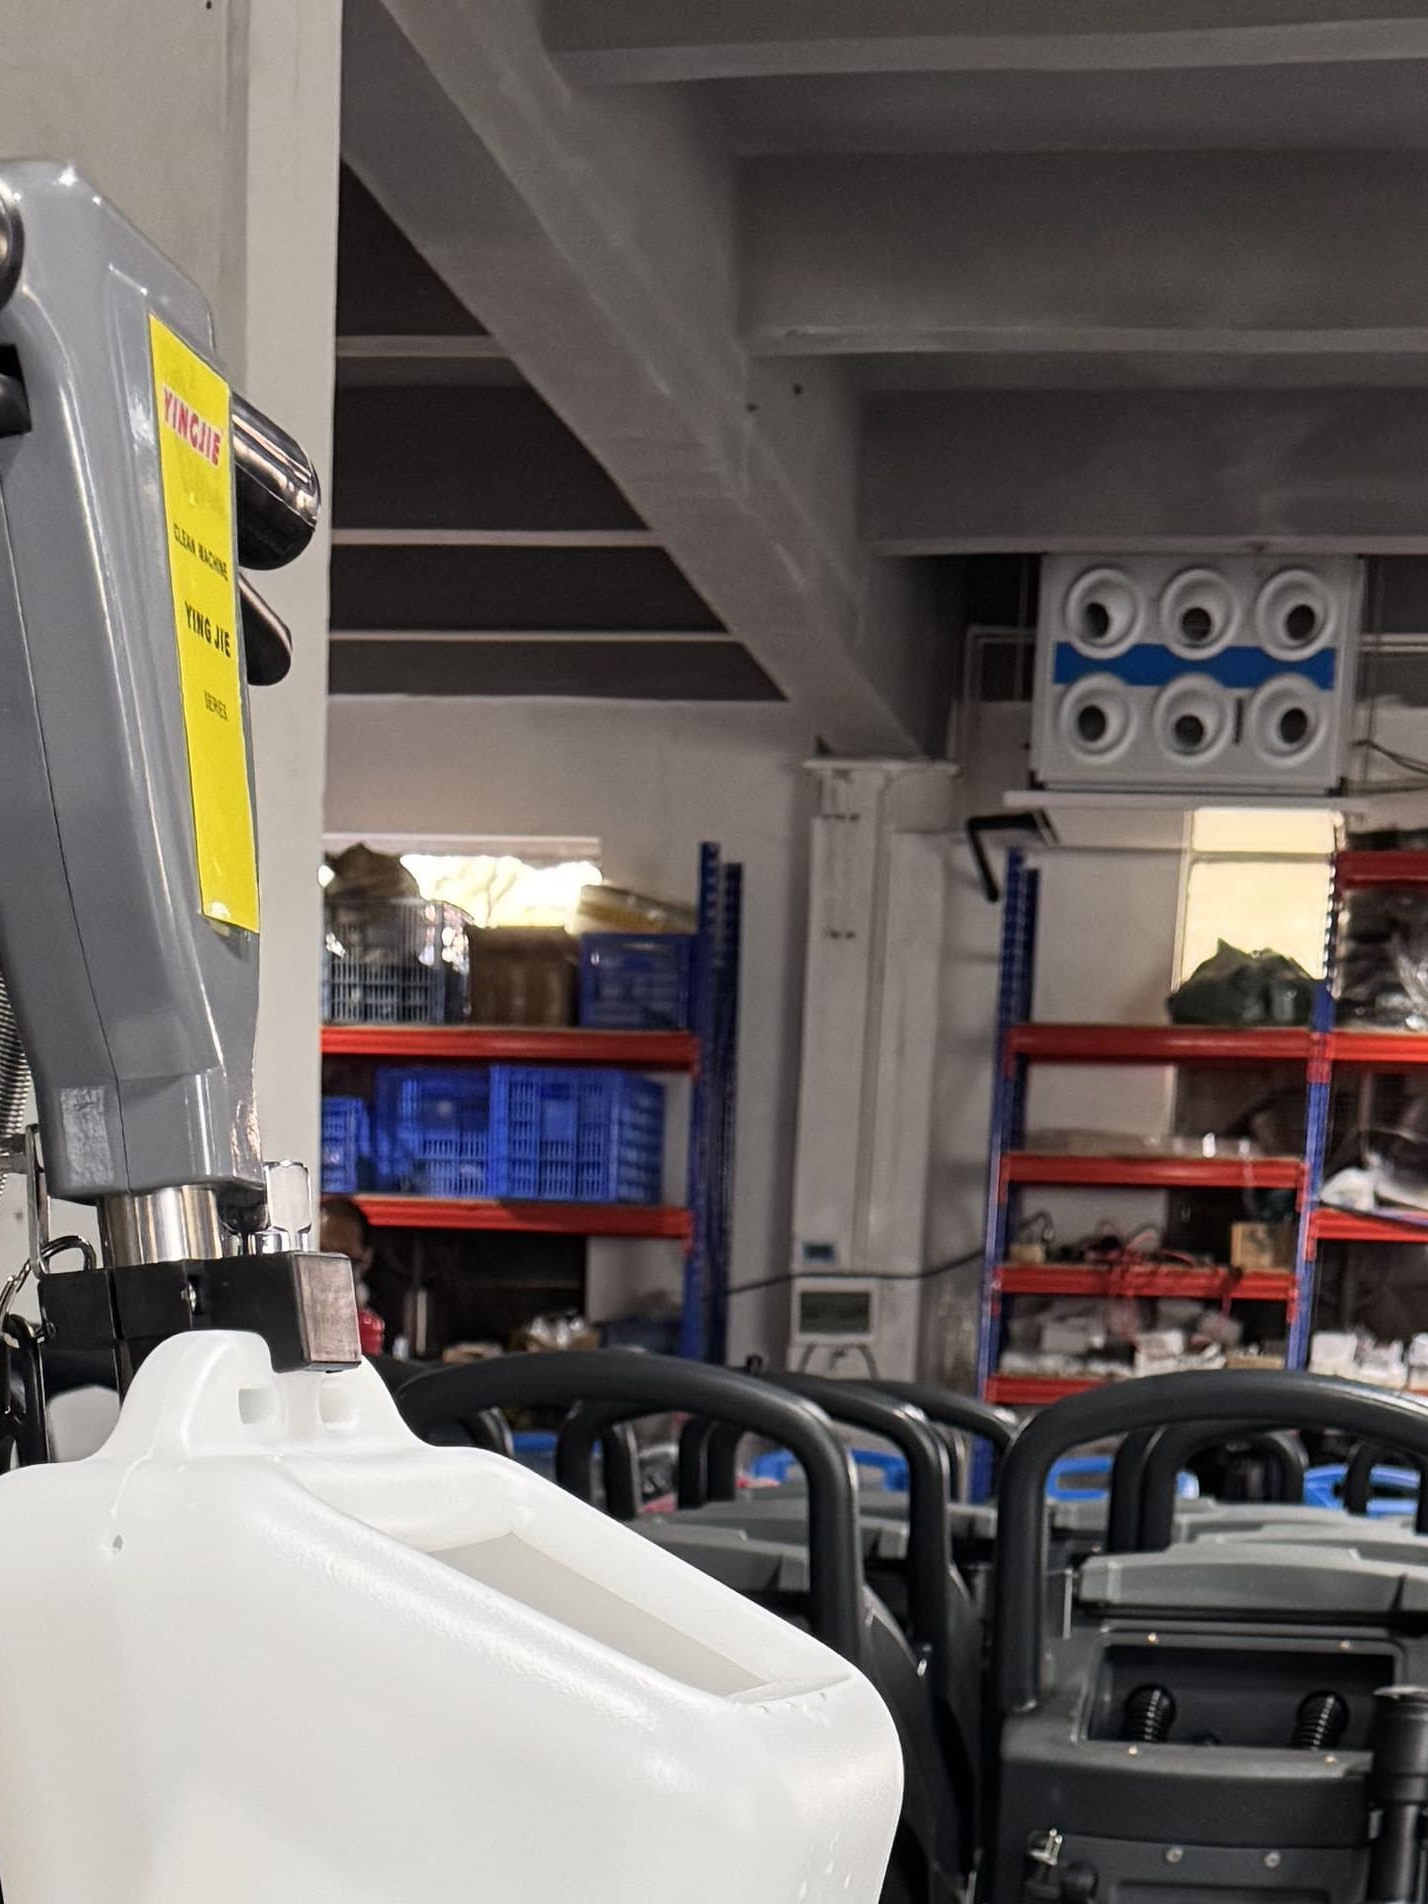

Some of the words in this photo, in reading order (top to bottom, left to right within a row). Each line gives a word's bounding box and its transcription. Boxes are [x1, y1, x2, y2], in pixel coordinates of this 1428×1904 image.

[163, 386, 221, 467] YINGJIE
[173, 523, 196, 555] CLEAN
[198, 540, 228, 582] MACHINE
[185, 601, 212, 645] YING
[214, 624, 231, 659] JIE
